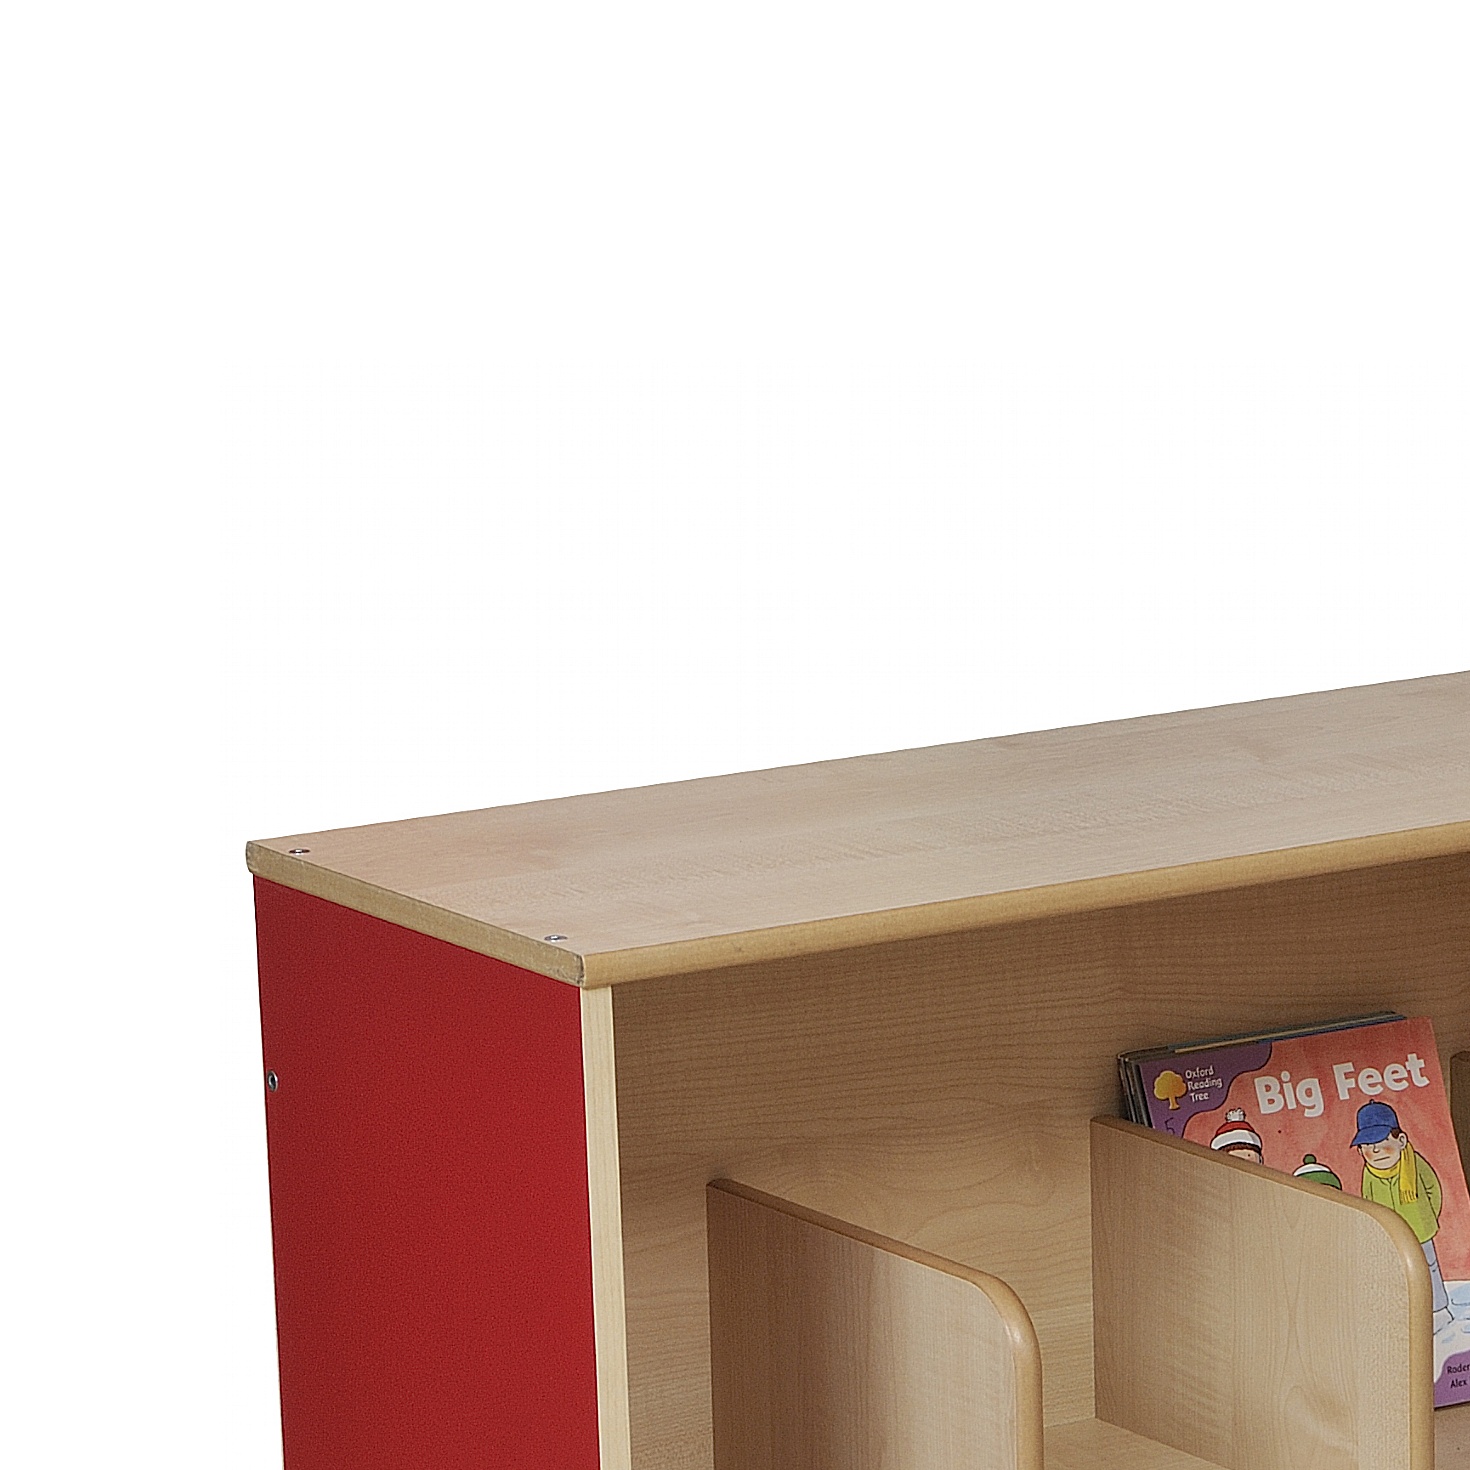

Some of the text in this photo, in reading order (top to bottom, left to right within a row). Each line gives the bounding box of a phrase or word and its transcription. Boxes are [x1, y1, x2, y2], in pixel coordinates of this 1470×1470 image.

[1185, 1065, 1214, 1079] Oxford
[1188, 1077, 1223, 1091] Reading
[1254, 1052, 1430, 1117] Big Feet
[1189, 1092, 1209, 1102] Tree
[1450, 1378, 1467, 1388] Alex
